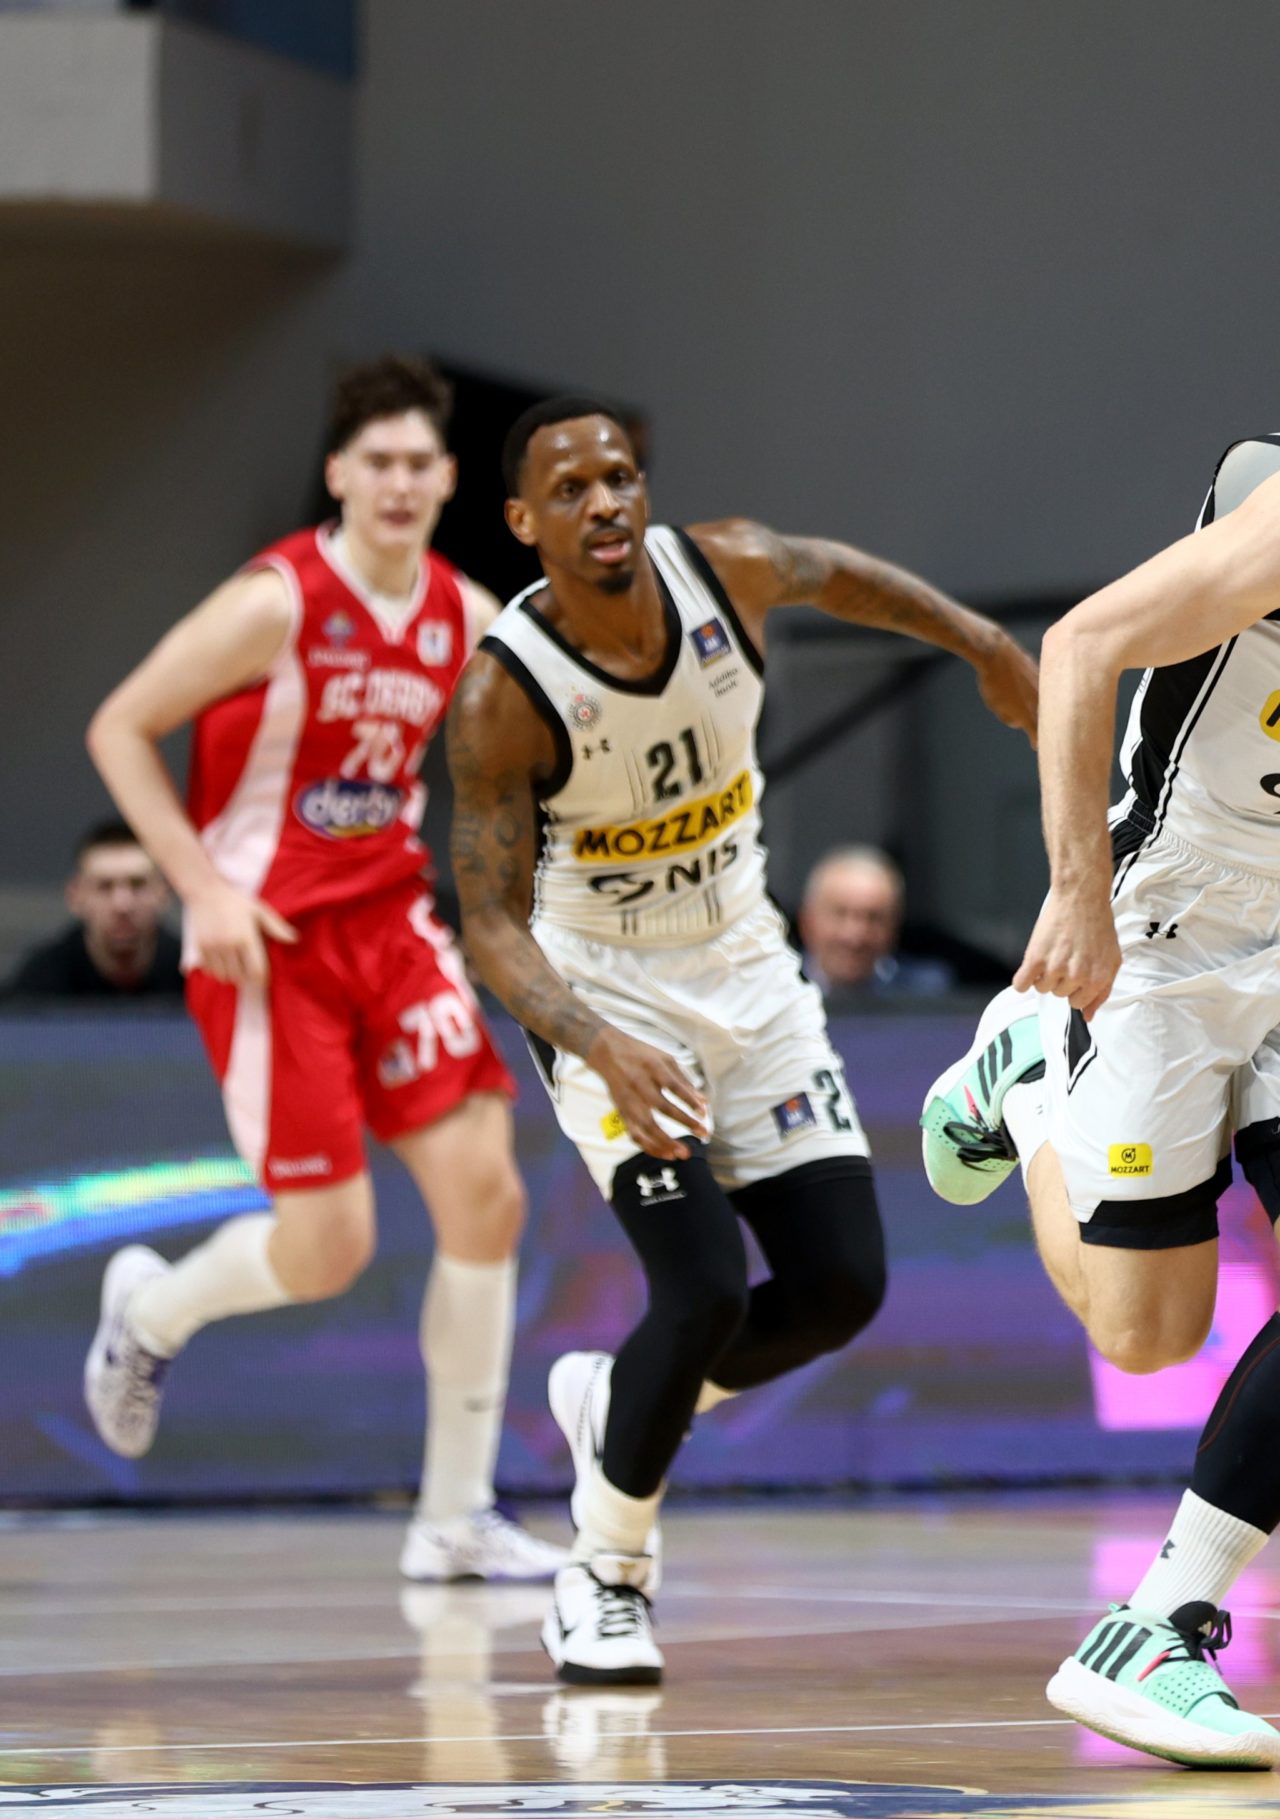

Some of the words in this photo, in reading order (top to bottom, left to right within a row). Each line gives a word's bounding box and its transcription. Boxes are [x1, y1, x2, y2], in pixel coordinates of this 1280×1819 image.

[646, 728, 703, 800] 21
[576, 773, 750, 858] MOZZART
[666, 840, 738, 893] NIS
[399, 990, 481, 1072] 70
[1111, 1165, 1150, 1174] MOZZART
